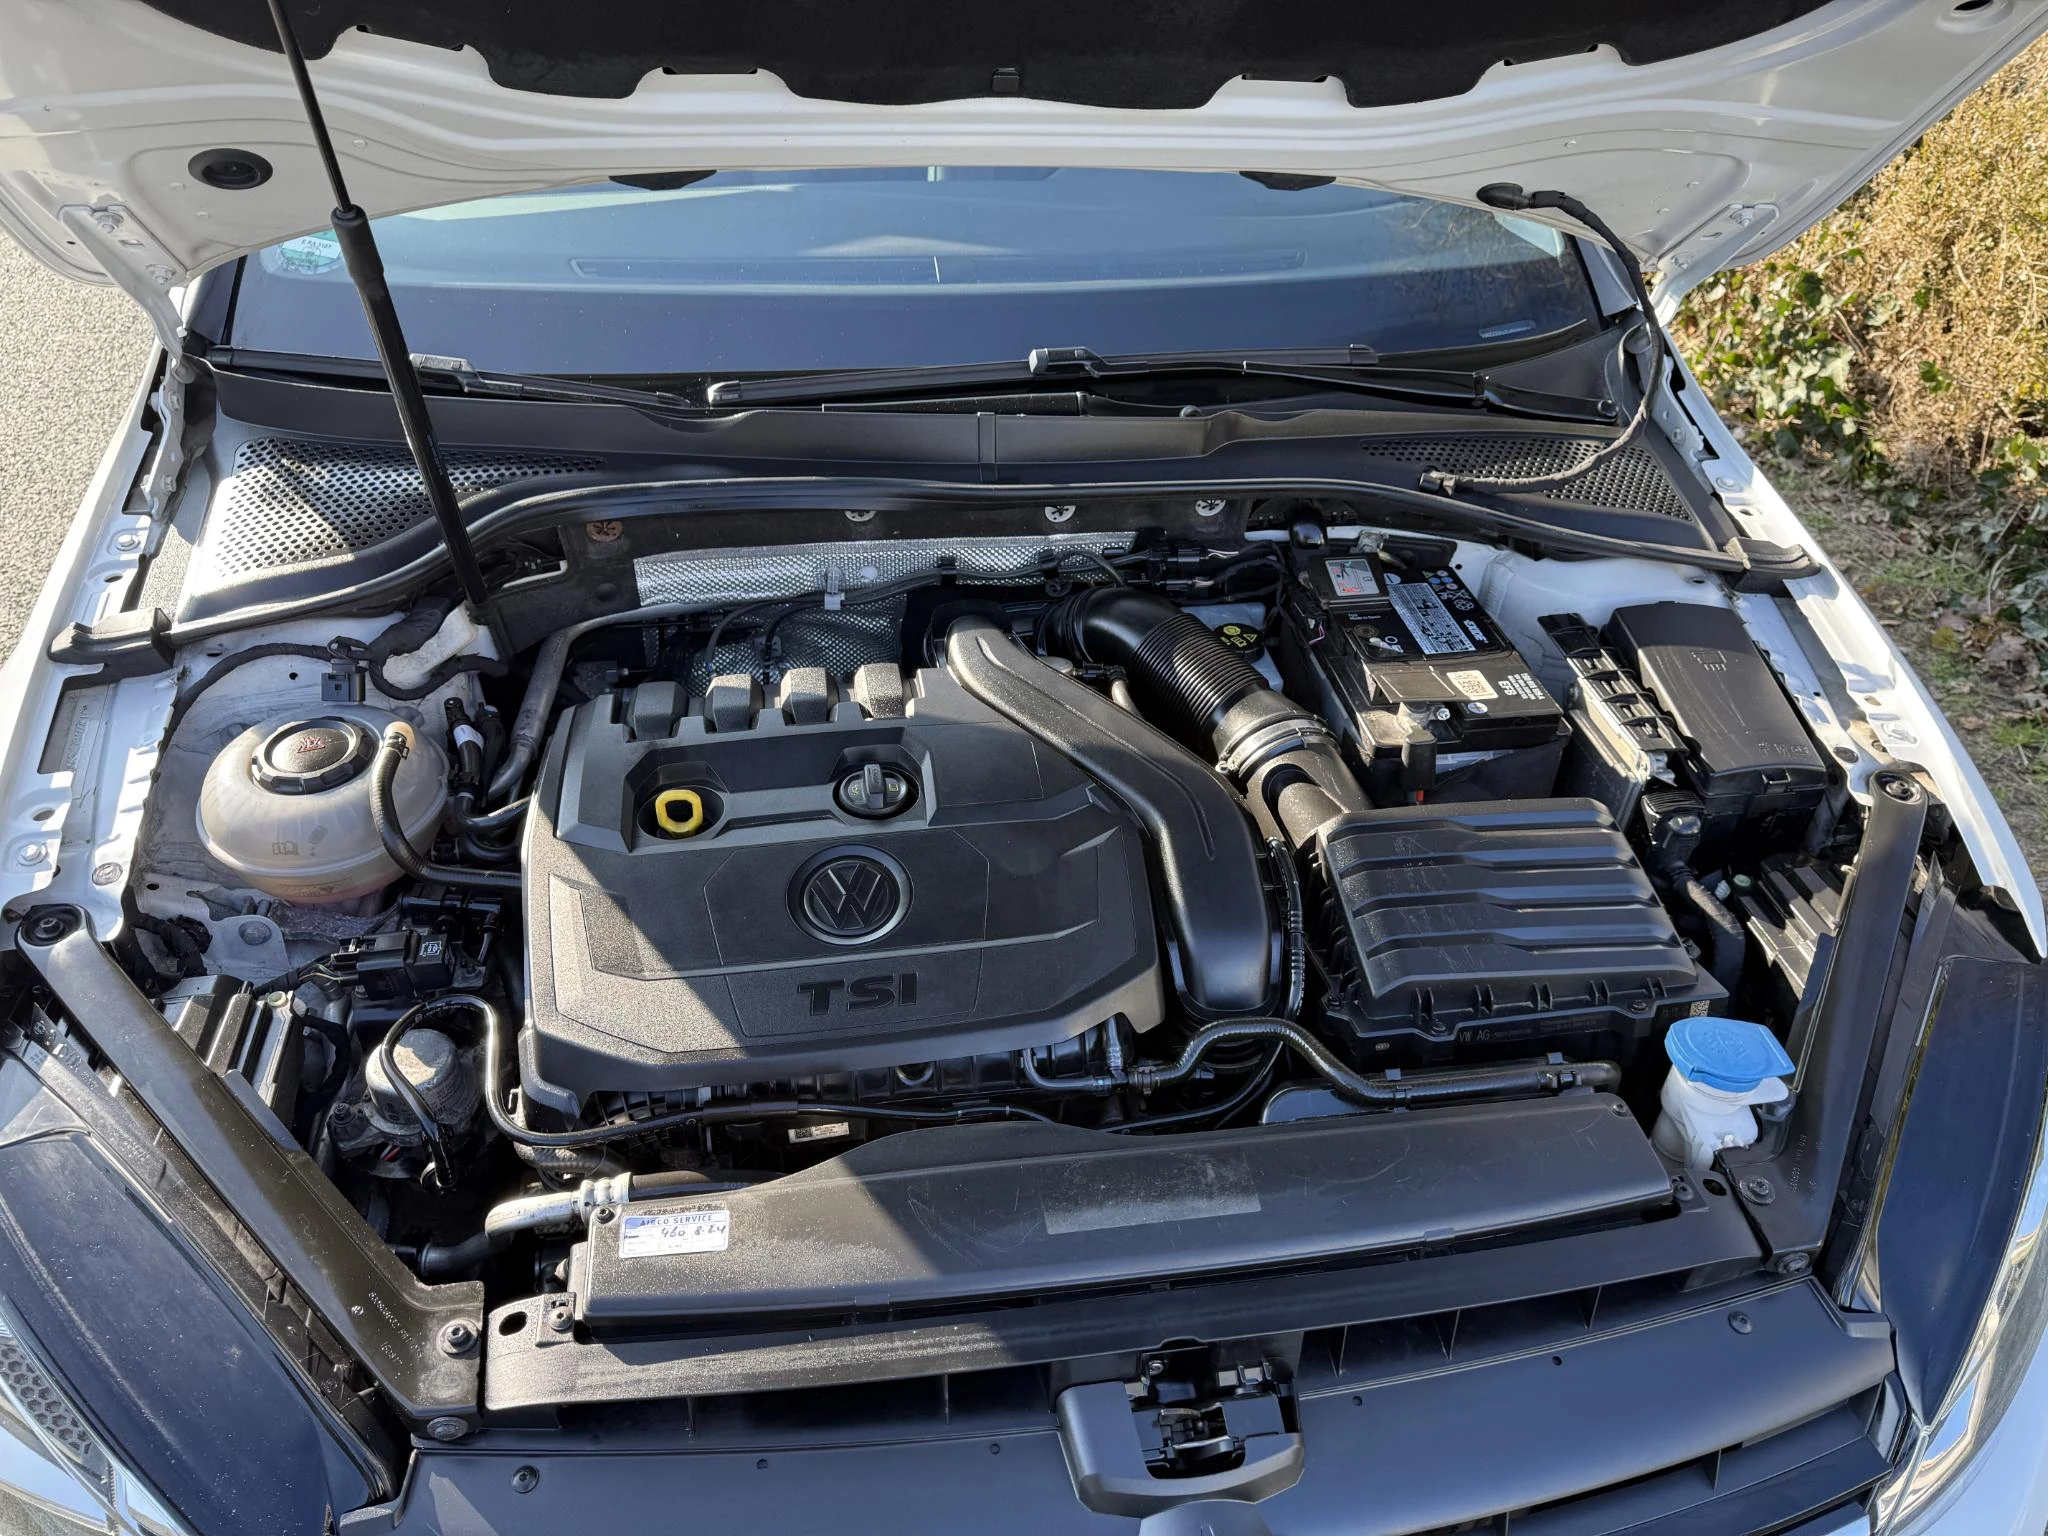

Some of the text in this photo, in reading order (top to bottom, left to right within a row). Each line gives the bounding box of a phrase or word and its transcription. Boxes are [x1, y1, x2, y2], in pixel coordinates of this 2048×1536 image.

[1497, 680, 1518, 696] EFB
[804, 860, 898, 935] VW
[797, 971, 919, 1016] TSI
[1459, 1031, 1472, 1042] VW
[1476, 1029, 1490, 1041] AG
[640, 1214, 712, 1227] AIRCO SERVICE
[661, 1226, 686, 1238] 460
